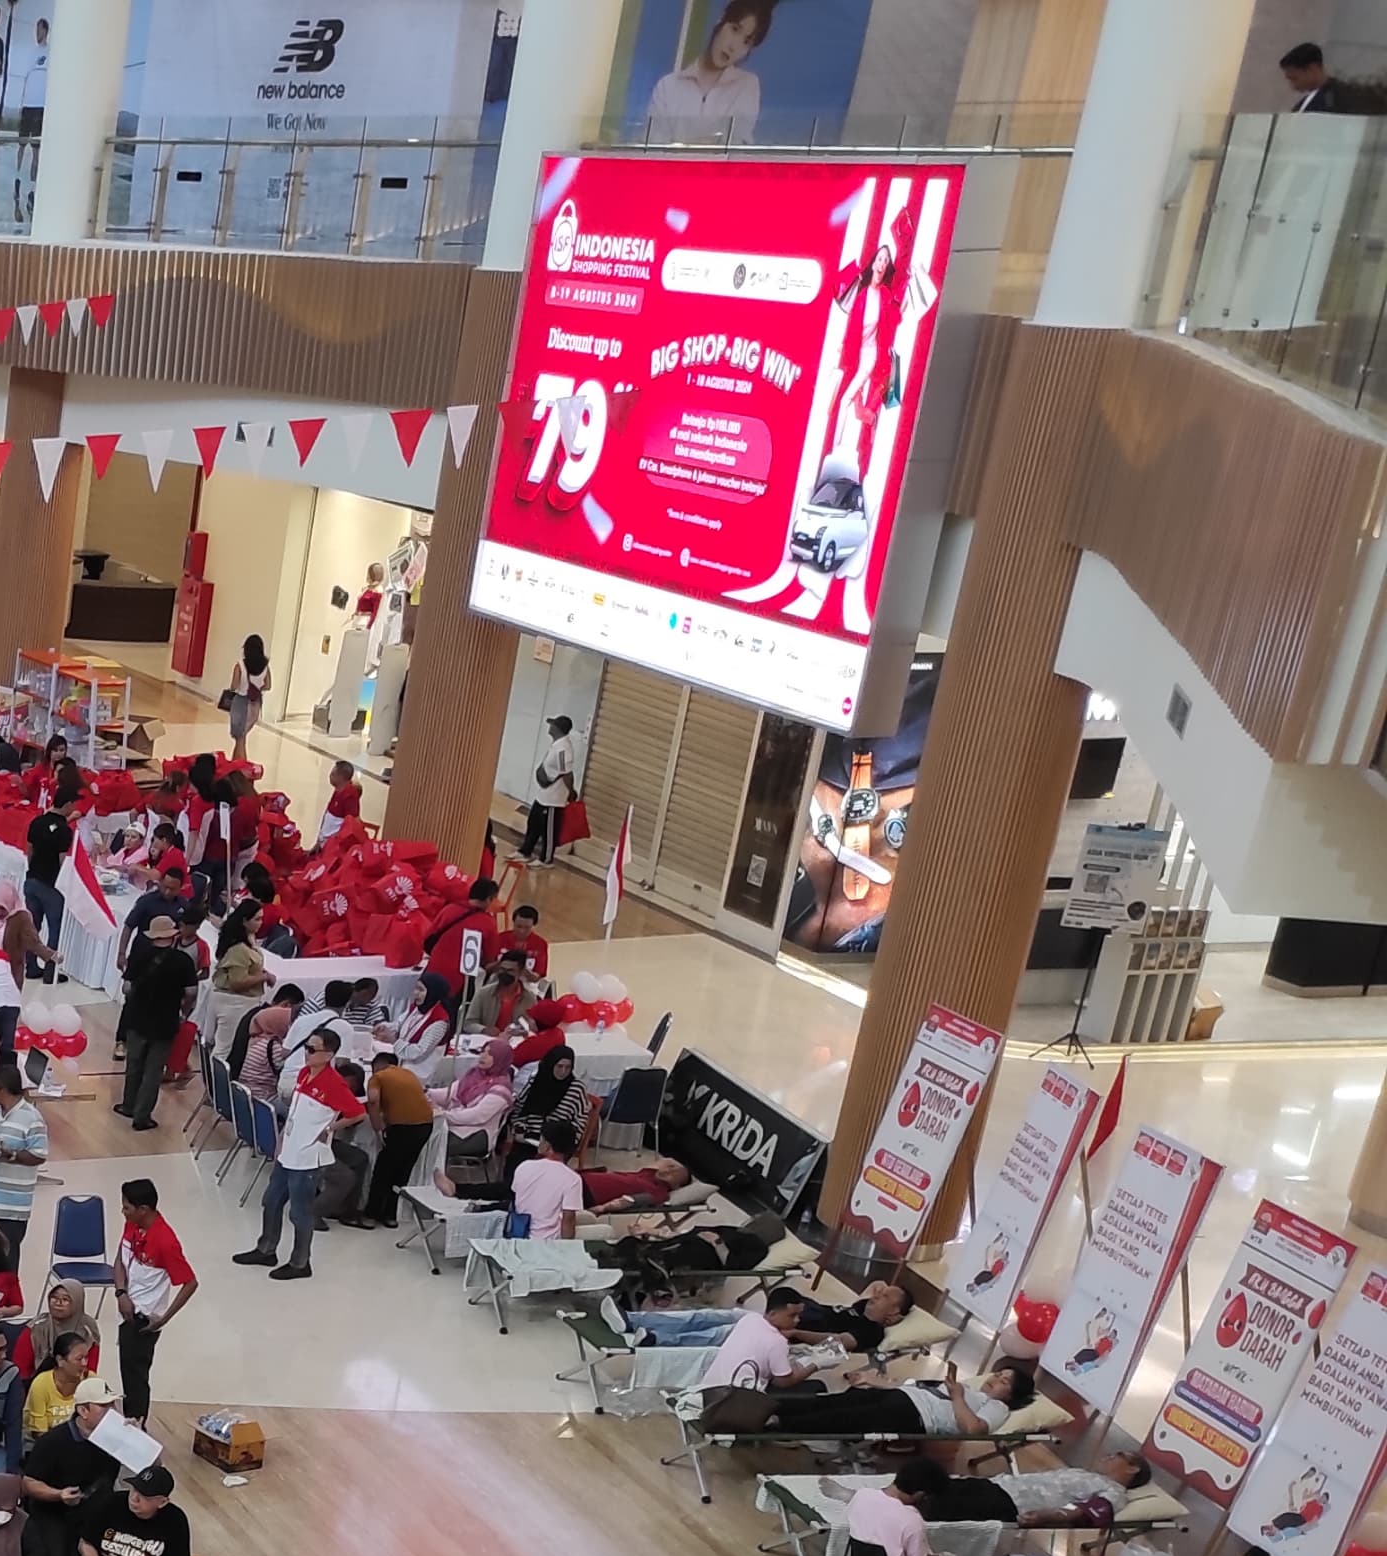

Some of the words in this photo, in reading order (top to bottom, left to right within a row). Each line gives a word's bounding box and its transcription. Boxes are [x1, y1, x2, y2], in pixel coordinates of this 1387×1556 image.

[257, 83, 284, 99] new
[288, 81, 345, 99] balance
[267, 113, 282, 129] We
[284, 113, 301, 130] Got
[575, 234, 655, 262] INDONESIA
[572, 260, 613, 276] SHOPPING
[613, 263, 651, 280] FESTIVAL
[573, 289, 613, 305] AGUSTUS
[615, 293, 637, 307] 2024
[547, 327, 595, 355] Discount
[594, 337, 608, 361] up
[608, 339, 623, 357] to
[650, 341, 679, 380] BIG
[681, 334, 727, 367] SHOP
[731, 336, 761, 372] BIG
[461, 936, 479, 974] 6
[921, 1086, 956, 1117] DONOR
[914, 1111, 950, 1143] DARAH
[1107, 1199, 1136, 1221] DARAH
[1135, 1217, 1158, 1236] ANDA
[1145, 1204, 1169, 1225] TETES
[1097, 1226, 1117, 1244] BAGI
[1118, 1237, 1140, 1257] YANG
[1101, 1213, 1134, 1237] ADALAH
[1135, 1233, 1163, 1255] NYAWA
[1248, 1300, 1295, 1345] DONOR
[1239, 1332, 1287, 1373] DARAH
[1323, 1346, 1359, 1375] DARAH
[1357, 1367, 1385, 1390] ANDA
[1315, 1360, 1356, 1390] ADALAH
[1308, 1374, 1334, 1395] BAGI
[1335, 1388, 1363, 1412] YANG
